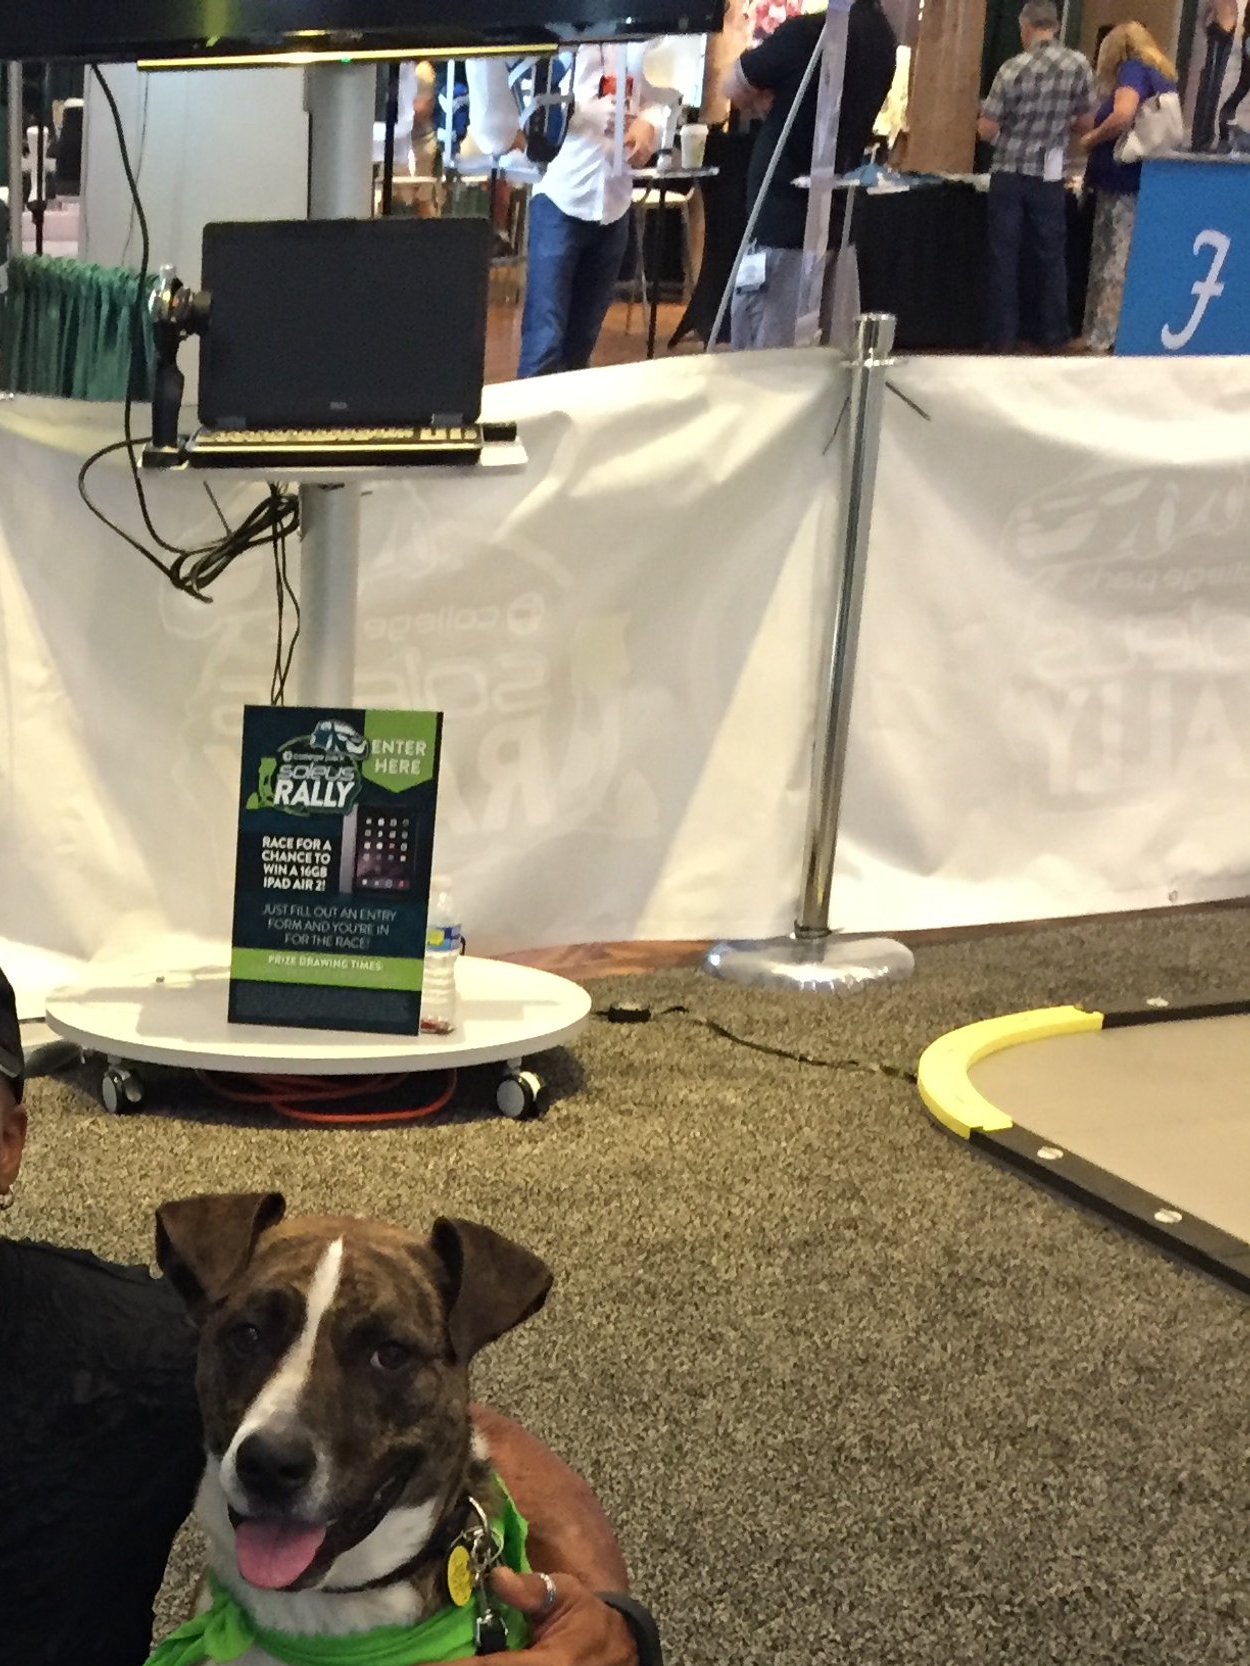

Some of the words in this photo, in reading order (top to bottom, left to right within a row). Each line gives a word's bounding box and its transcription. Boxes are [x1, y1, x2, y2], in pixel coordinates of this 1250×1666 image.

[371, 739, 427, 756] ENTER
[375, 758, 421, 775] HERE
[273, 779, 355, 808] RALLY
[262, 835, 295, 850] RACE
[296, 837, 321, 851] FOR
[322, 839, 332, 851] A
[261, 849, 312, 864] CHANCE
[314, 852, 331, 865] TO
[263, 862, 288, 876] WIN
[288, 864, 299, 877] A
[300, 865, 328, 879] 16GB
[263, 876, 292, 890] IPAD
[292, 878, 314, 892] AIR
[262, 903, 288, 916] JUST
[290, 904, 310, 917] FILL
[313, 905, 338, 919] OUT
[340, 908, 357, 920] AN
[360, 909, 398, 922] ENTRY
[268, 918, 302, 931] FORM
[304, 920, 330, 933] AND
[332, 921, 372, 936] YOU'RE
[376, 924, 390, 936] IN
[284, 933, 310, 946] FOR
[311, 935, 332, 948] THE
[268, 954, 296, 966] PRIZE
[299, 956, 349, 970] DRAWING
